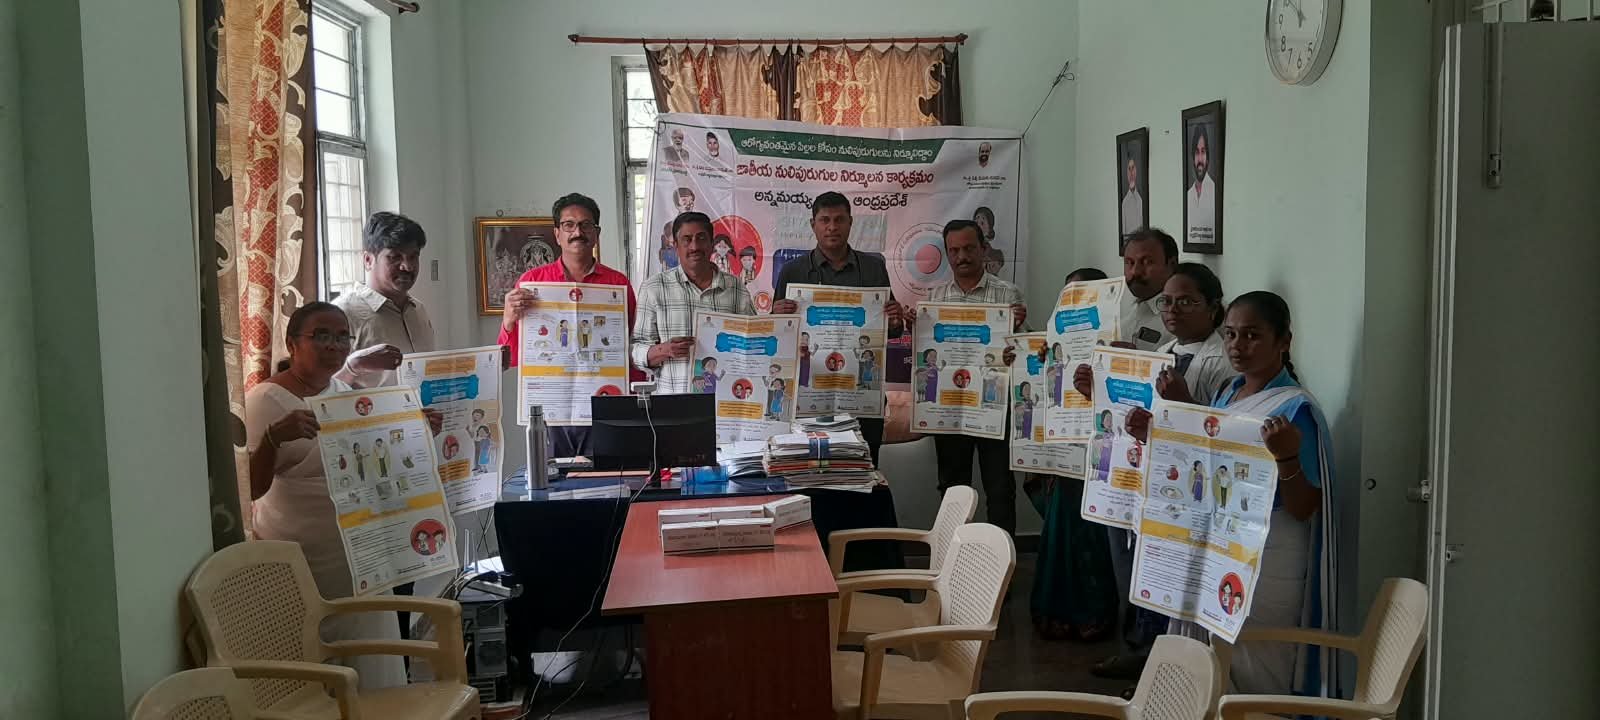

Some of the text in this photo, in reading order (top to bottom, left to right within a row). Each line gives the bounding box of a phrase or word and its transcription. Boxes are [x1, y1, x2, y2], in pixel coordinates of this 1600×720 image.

[1281, 35, 1286, 52] 8
[1286, 48, 1293, 72] 7
[741, 137, 796, 154] ఆరోగ్యవంతమైన
[797, 142, 816, 154] పిల్లల
[817, 141, 837, 153] కోసం
[736, 160, 773, 177] జాతీయ
[774, 165, 838, 182] నులిపురుగుల
[840, 169, 884, 188] నిర్మూలన
[886, 170, 934, 189] కార్యక్రమం
[754, 190, 909, 211] అన్నమయ్య ఆంధ్రప్రదేశ్
